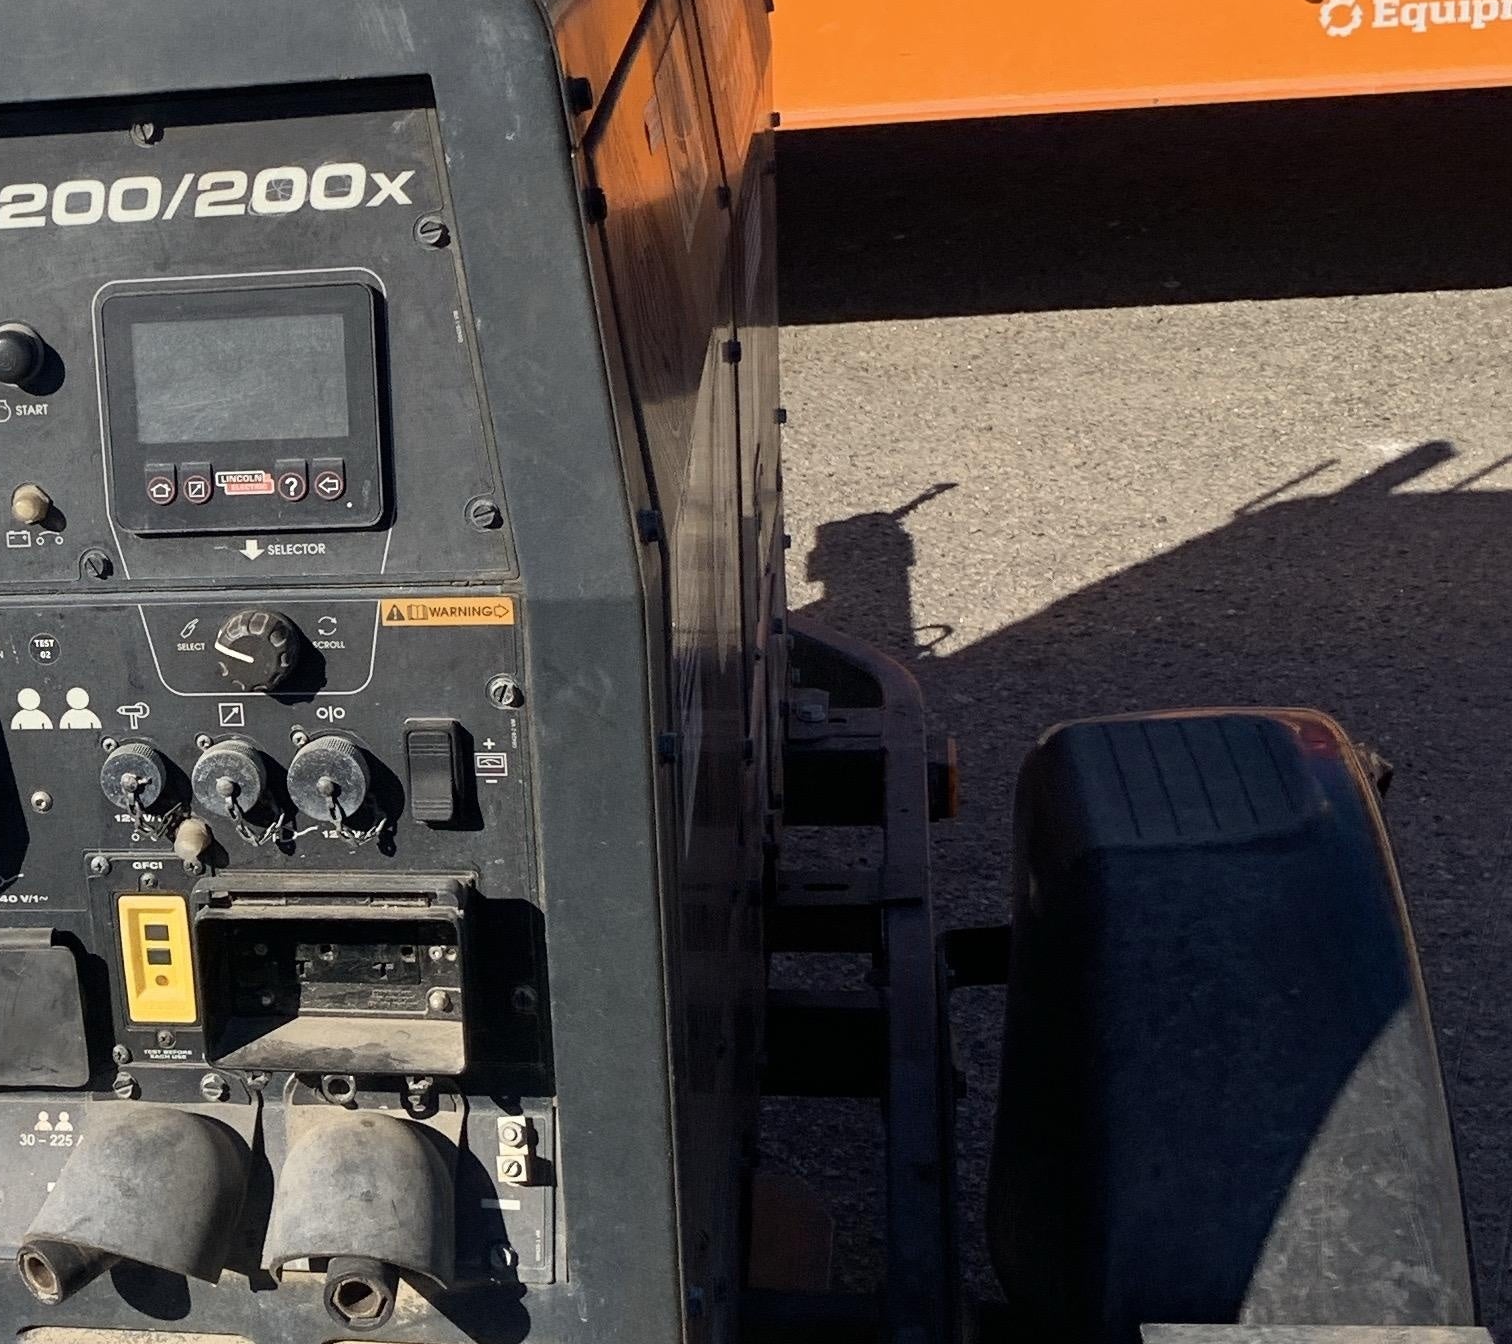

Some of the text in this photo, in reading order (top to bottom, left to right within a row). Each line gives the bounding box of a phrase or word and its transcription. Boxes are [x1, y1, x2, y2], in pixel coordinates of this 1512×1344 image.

[15, 404, 49, 417] START
[220, 474, 263, 483] LINCOLN
[268, 543, 326, 556] SELECTOR
[429, 605, 493, 617] WARNING
[34, 639, 55, 648] TEST
[177, 641, 206, 651] SELECT
[313, 640, 345, 649] SCROLL
[131, 861, 163, 870] GFCI
[19, 1134, 36, 1147] 30
[49, 1134, 73, 1146] 225
